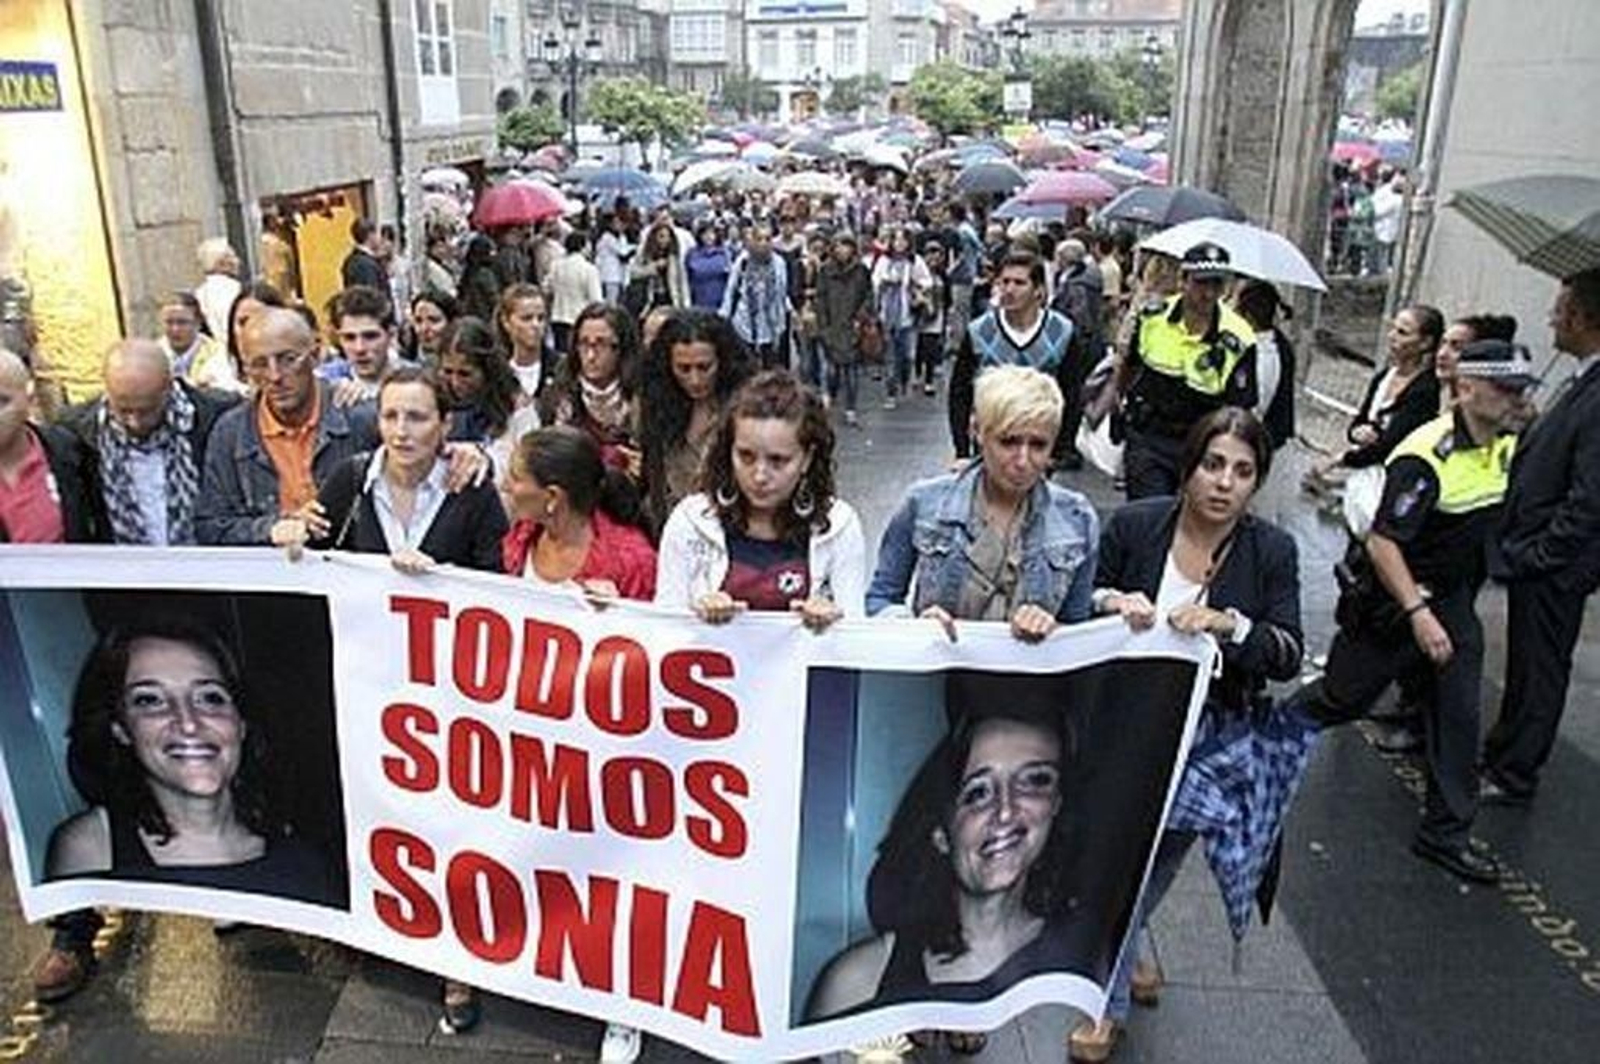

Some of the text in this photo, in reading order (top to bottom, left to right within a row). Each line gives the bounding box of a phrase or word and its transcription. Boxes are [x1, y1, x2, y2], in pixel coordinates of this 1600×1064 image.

[389, 595, 738, 740] TODOS
[381, 703, 749, 859] SOMOS
[369, 827, 762, 1038] SONIA
